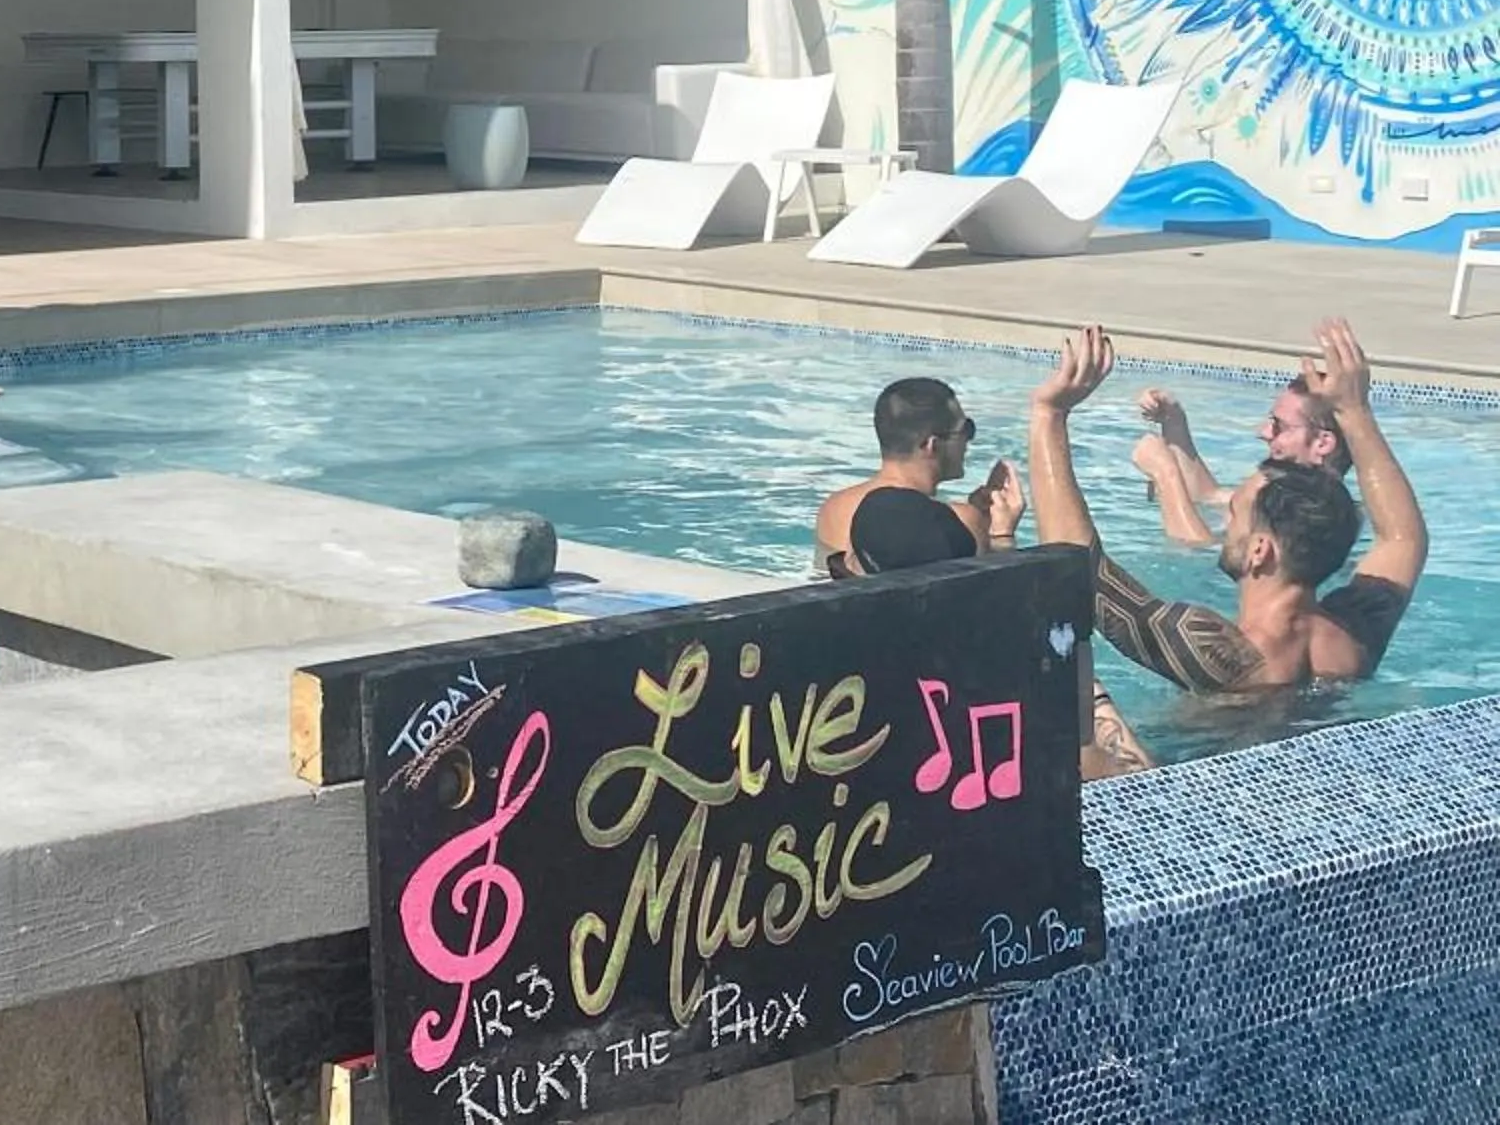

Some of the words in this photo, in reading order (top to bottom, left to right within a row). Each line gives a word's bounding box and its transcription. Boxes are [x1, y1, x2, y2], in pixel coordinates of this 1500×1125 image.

[386, 659, 490, 759] TODAY
[575, 640, 891, 849] Live
[569, 782, 934, 1029] Music
[472, 964, 555, 1049] 12-3
[842, 933, 985, 1022] Seaview
[1038, 907, 1086, 956] Bar
[432, 1050, 596, 1125] RICKY
[605, 1029, 674, 1076] THE
